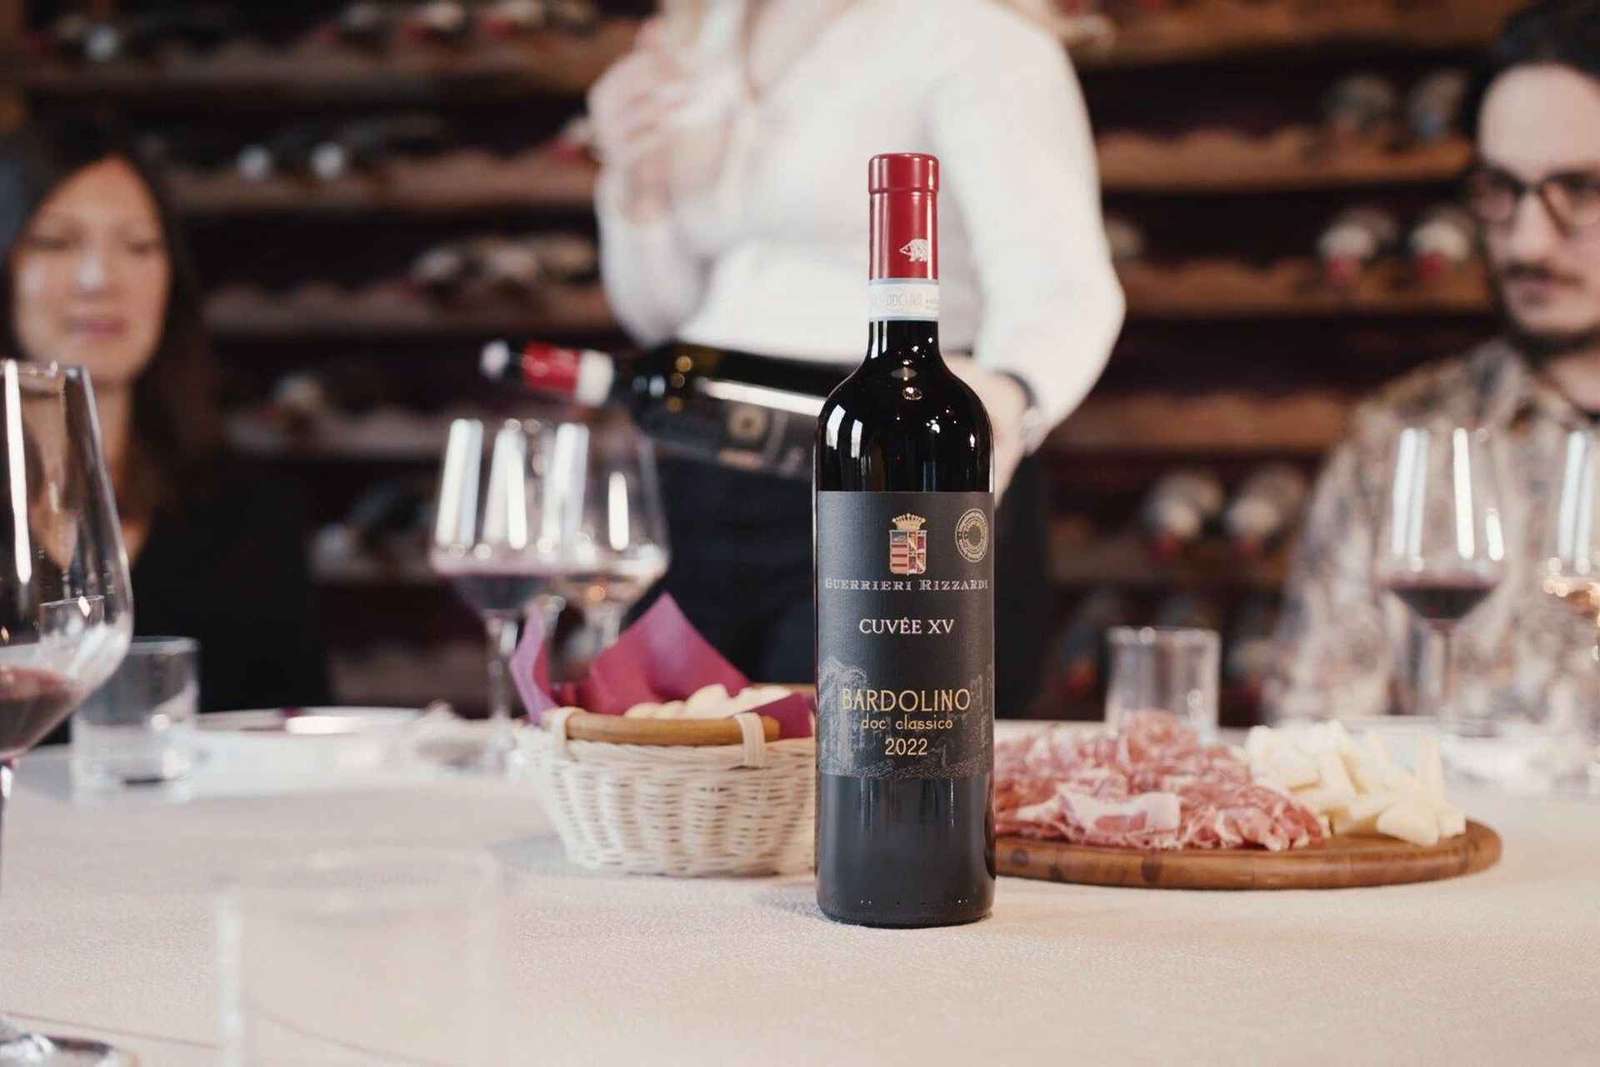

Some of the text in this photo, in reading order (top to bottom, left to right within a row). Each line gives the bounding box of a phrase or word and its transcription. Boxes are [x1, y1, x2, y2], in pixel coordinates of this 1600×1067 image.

[825, 578, 989, 591] GUERRIERI RIZZARDI
[859, 617, 954, 634] CUVÉE XV
[841, 688, 971, 712] BARDOLINO
[860, 713, 953, 730] doc classico
[885, 738, 928, 756] 2022
